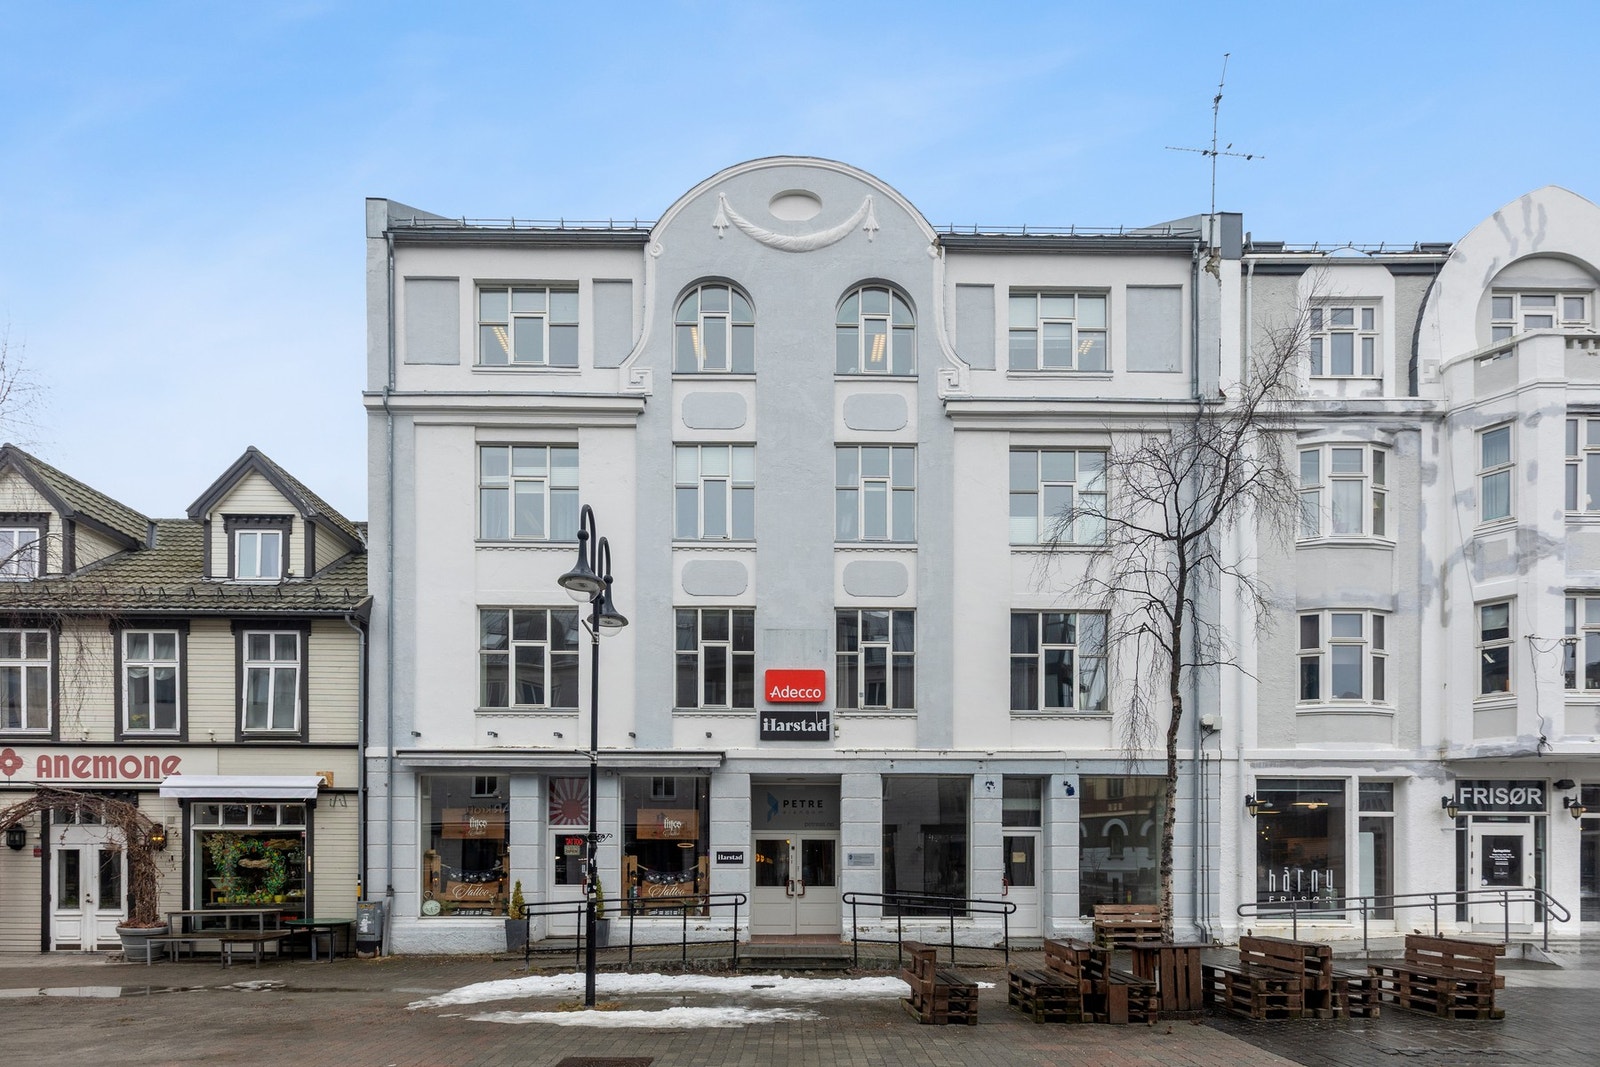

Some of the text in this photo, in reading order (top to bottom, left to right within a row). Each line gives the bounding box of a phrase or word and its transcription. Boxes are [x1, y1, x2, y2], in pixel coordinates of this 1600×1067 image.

[769, 685, 822, 699] Adecco
[1459, 786, 1543, 805] FRISØR
[783, 799, 824, 808] PETRE
[452, 883, 489, 900] Tattoo
[648, 883, 685, 898] Tattoo
